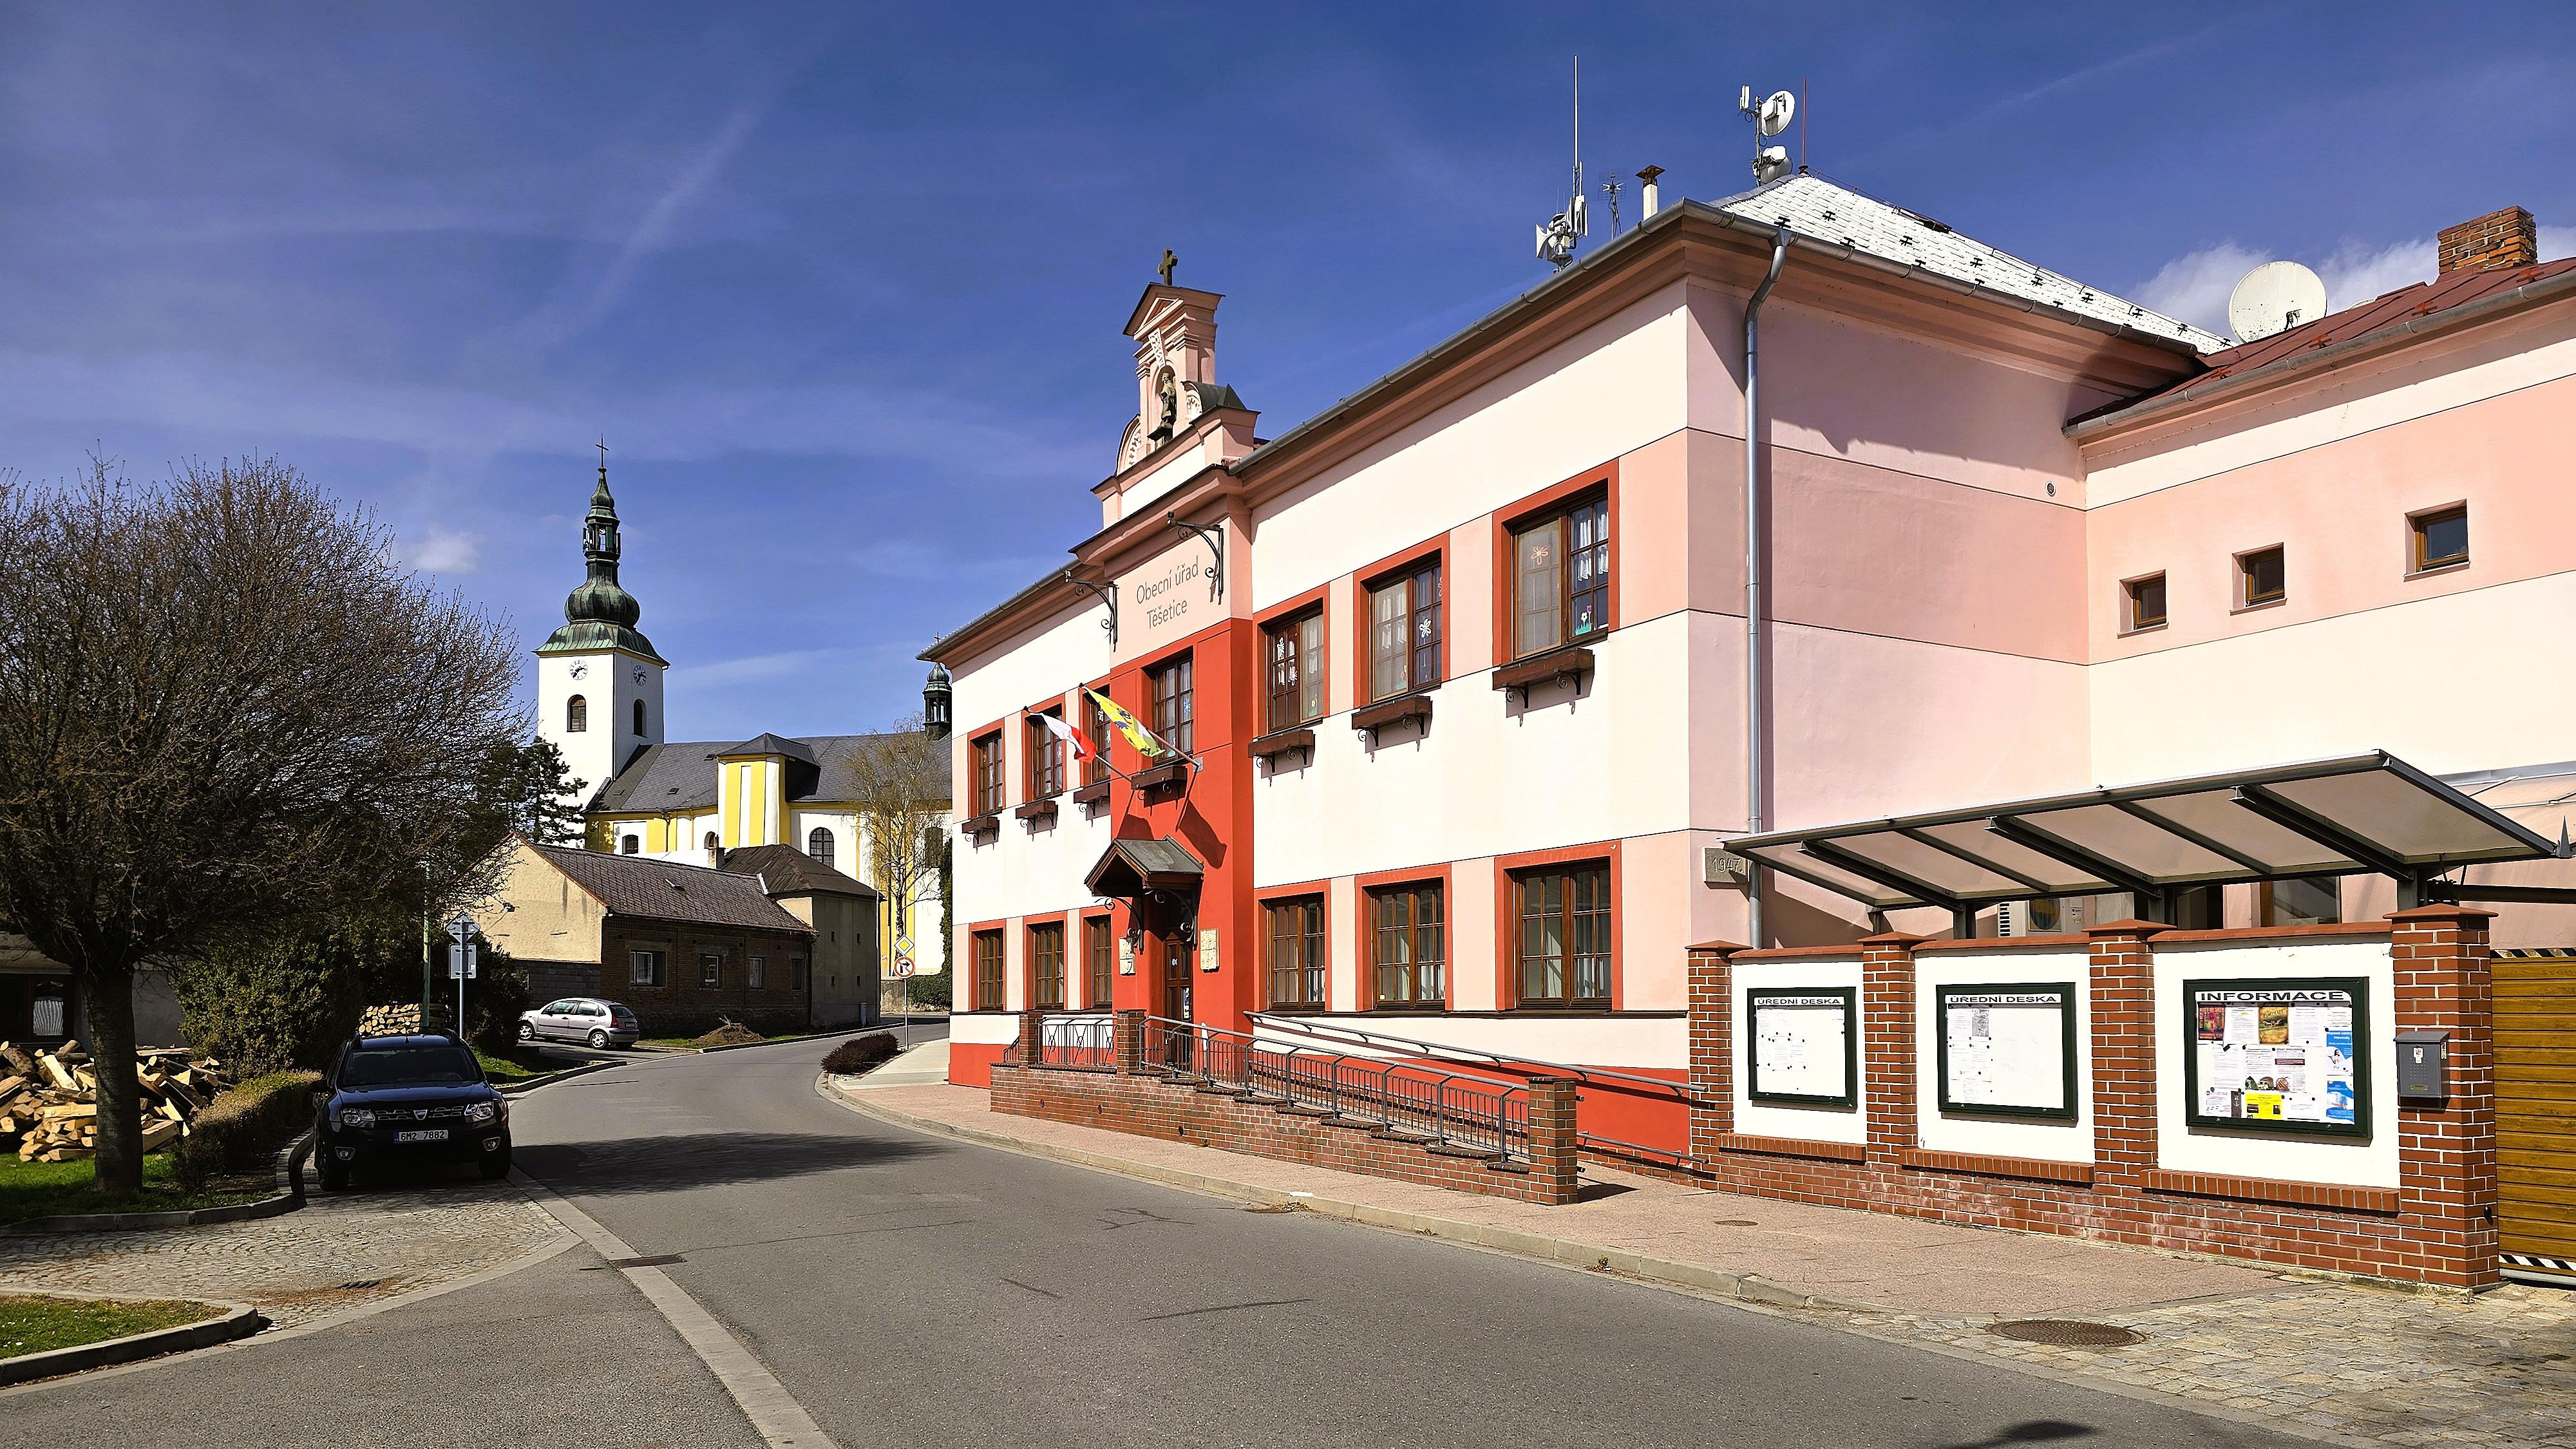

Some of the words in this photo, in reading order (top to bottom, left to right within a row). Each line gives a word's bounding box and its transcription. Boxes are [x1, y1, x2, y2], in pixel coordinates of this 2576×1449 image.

[1136, 569, 1172, 604] Obecní
[1175, 555, 1199, 586] úřad
[1146, 599, 1188, 629] Těšetice
[2201, 992, 2344, 1001] INFORMACE
[401, 1132, 417, 1141] 6M2
[423, 1131, 445, 1139] 7882
